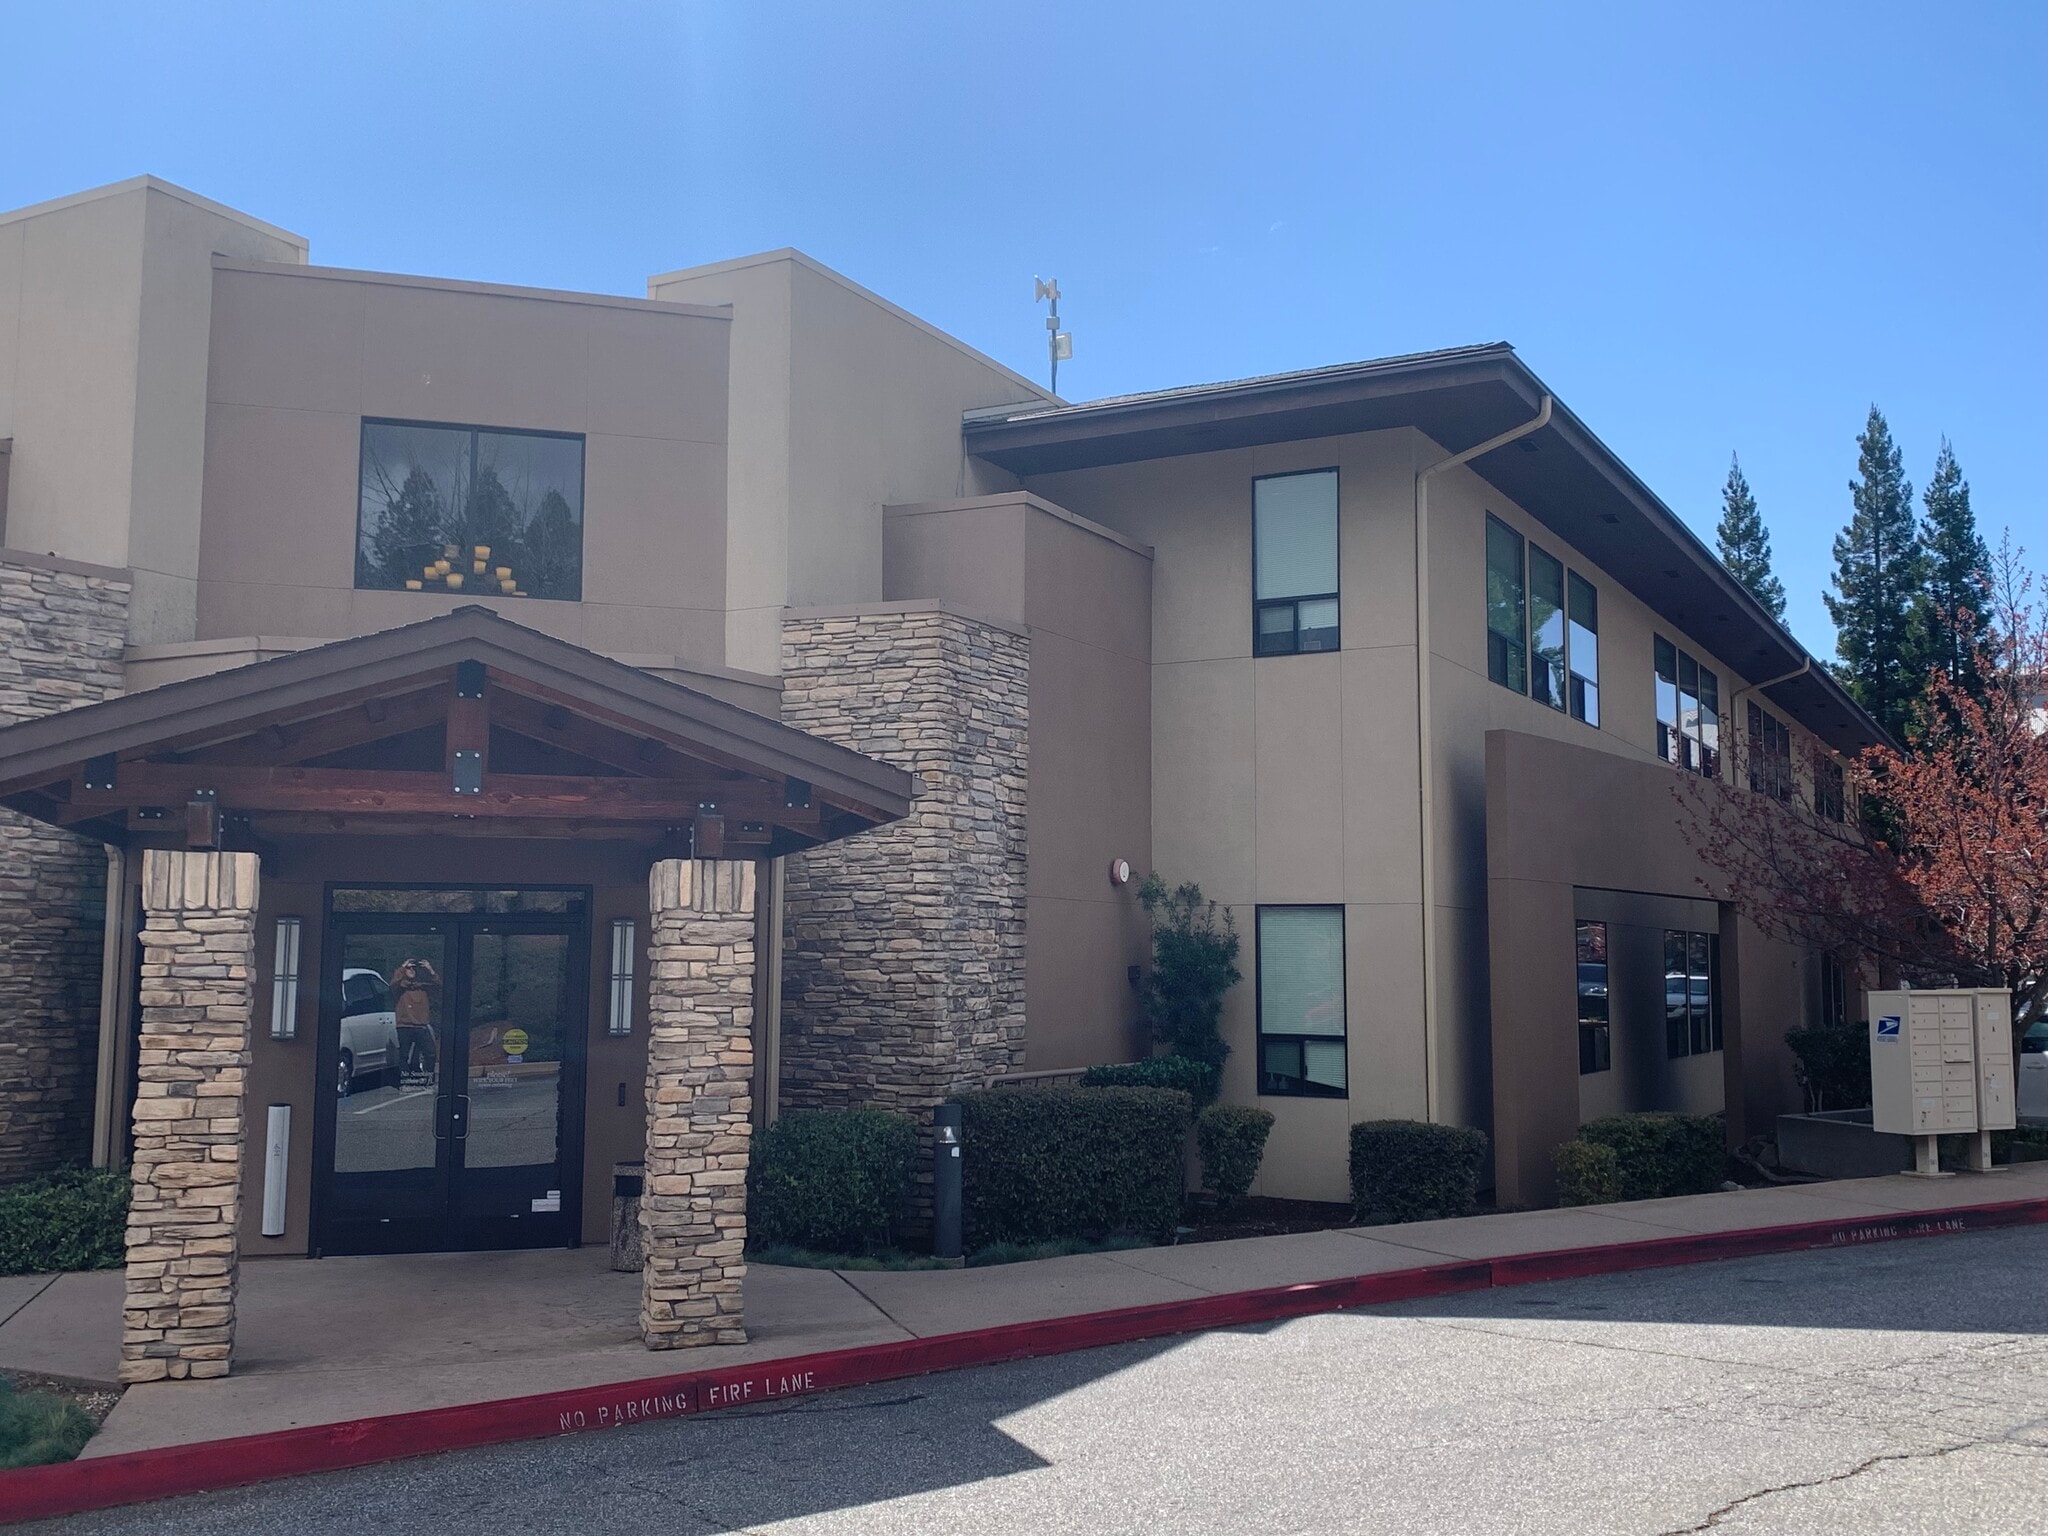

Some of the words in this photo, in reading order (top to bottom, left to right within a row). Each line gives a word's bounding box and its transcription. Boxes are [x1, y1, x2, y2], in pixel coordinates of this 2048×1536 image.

[1852, 1226, 1898, 1242] PARKING
[1937, 1218, 1966, 1231] LANE
[559, 1410, 586, 1430] NO
[598, 1393, 687, 1424] PARKING
[766, 1372, 815, 1395] LANE
